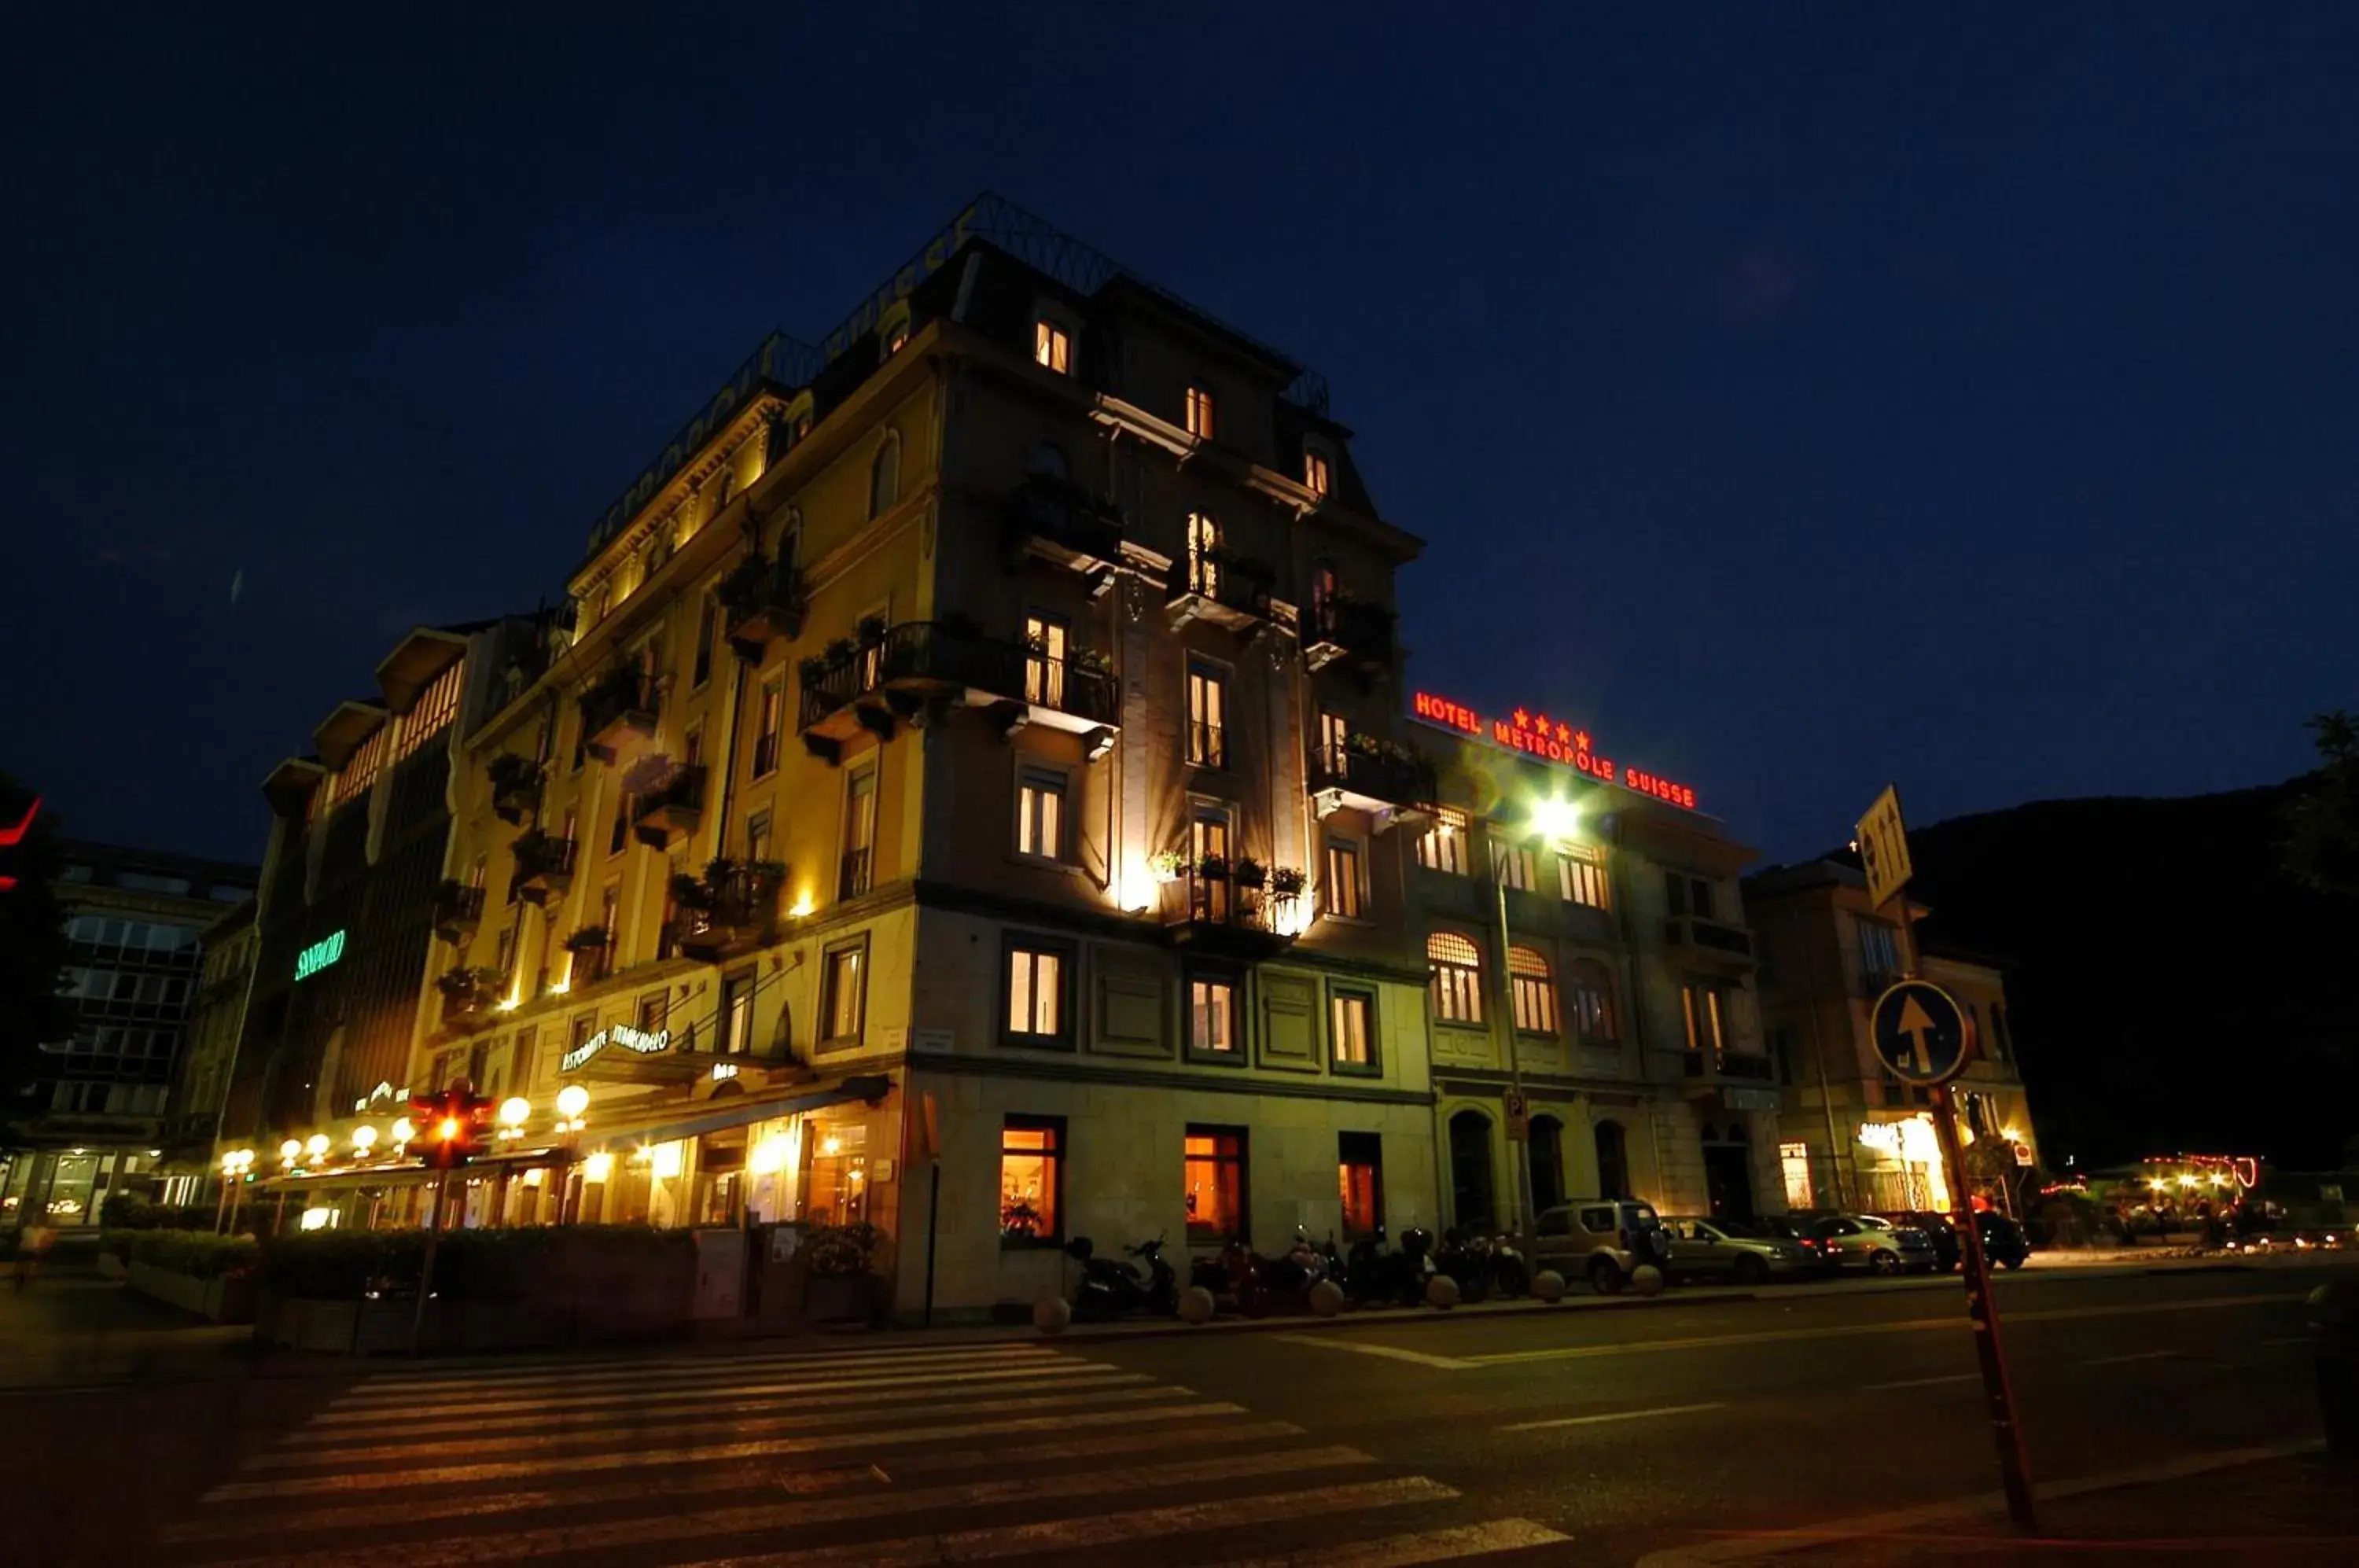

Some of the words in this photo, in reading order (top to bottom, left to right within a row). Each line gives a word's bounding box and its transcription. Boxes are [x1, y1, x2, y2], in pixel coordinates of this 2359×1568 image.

[1416, 692, 1482, 734] HOTEL
[1495, 720, 1614, 780] METROPOLE
[1627, 767, 1694, 808] SUISSE
